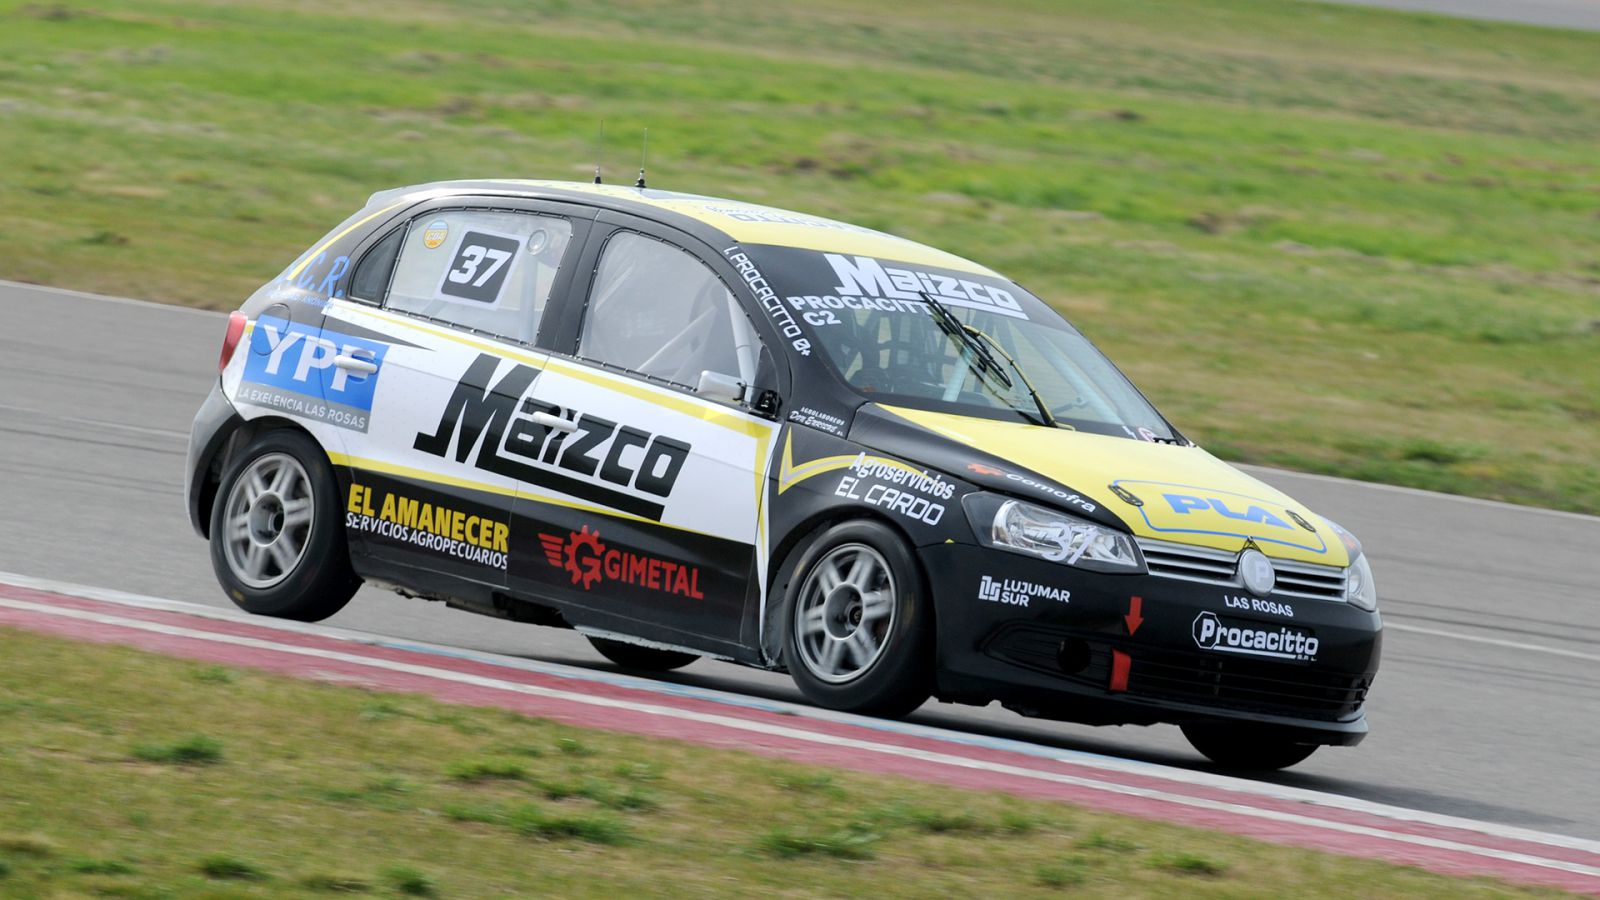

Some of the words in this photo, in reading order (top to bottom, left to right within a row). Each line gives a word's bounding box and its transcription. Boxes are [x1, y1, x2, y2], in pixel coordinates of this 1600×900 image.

[449, 244, 513, 287] 37
[824, 253, 1029, 320] Maizco
[730, 253, 802, 338] PROCACITTO
[786, 296, 933, 316] PROCACITT
[802, 310, 842, 327] C2
[264, 324, 376, 392] YPF
[238, 387, 249, 399] LA
[250, 389, 303, 412] EXELENCIA
[304, 403, 326, 417] LAS
[327, 410, 366, 428] ROSAS
[413, 353, 692, 522] Maizco
[849, 451, 955, 500] Agroservicios
[347, 483, 376, 517] EL
[379, 492, 510, 553] AMANECER
[835, 476, 860, 500] EL
[864, 484, 945, 526] CARDO
[1161, 494, 1296, 530] PLA
[345, 512, 408, 541] SERVICIOS
[408, 529, 508, 570] AGROPECUARIOS
[1041, 521, 1099, 565] 37
[604, 549, 704, 600] GIMETAL
[1003, 579, 1071, 603] LUJUMAR
[1001, 591, 1029, 607] SUR
[1224, 595, 1250, 609] LAS
[1252, 599, 1294, 617] ROSAS
[1200, 618, 1319, 656] Procacitto
